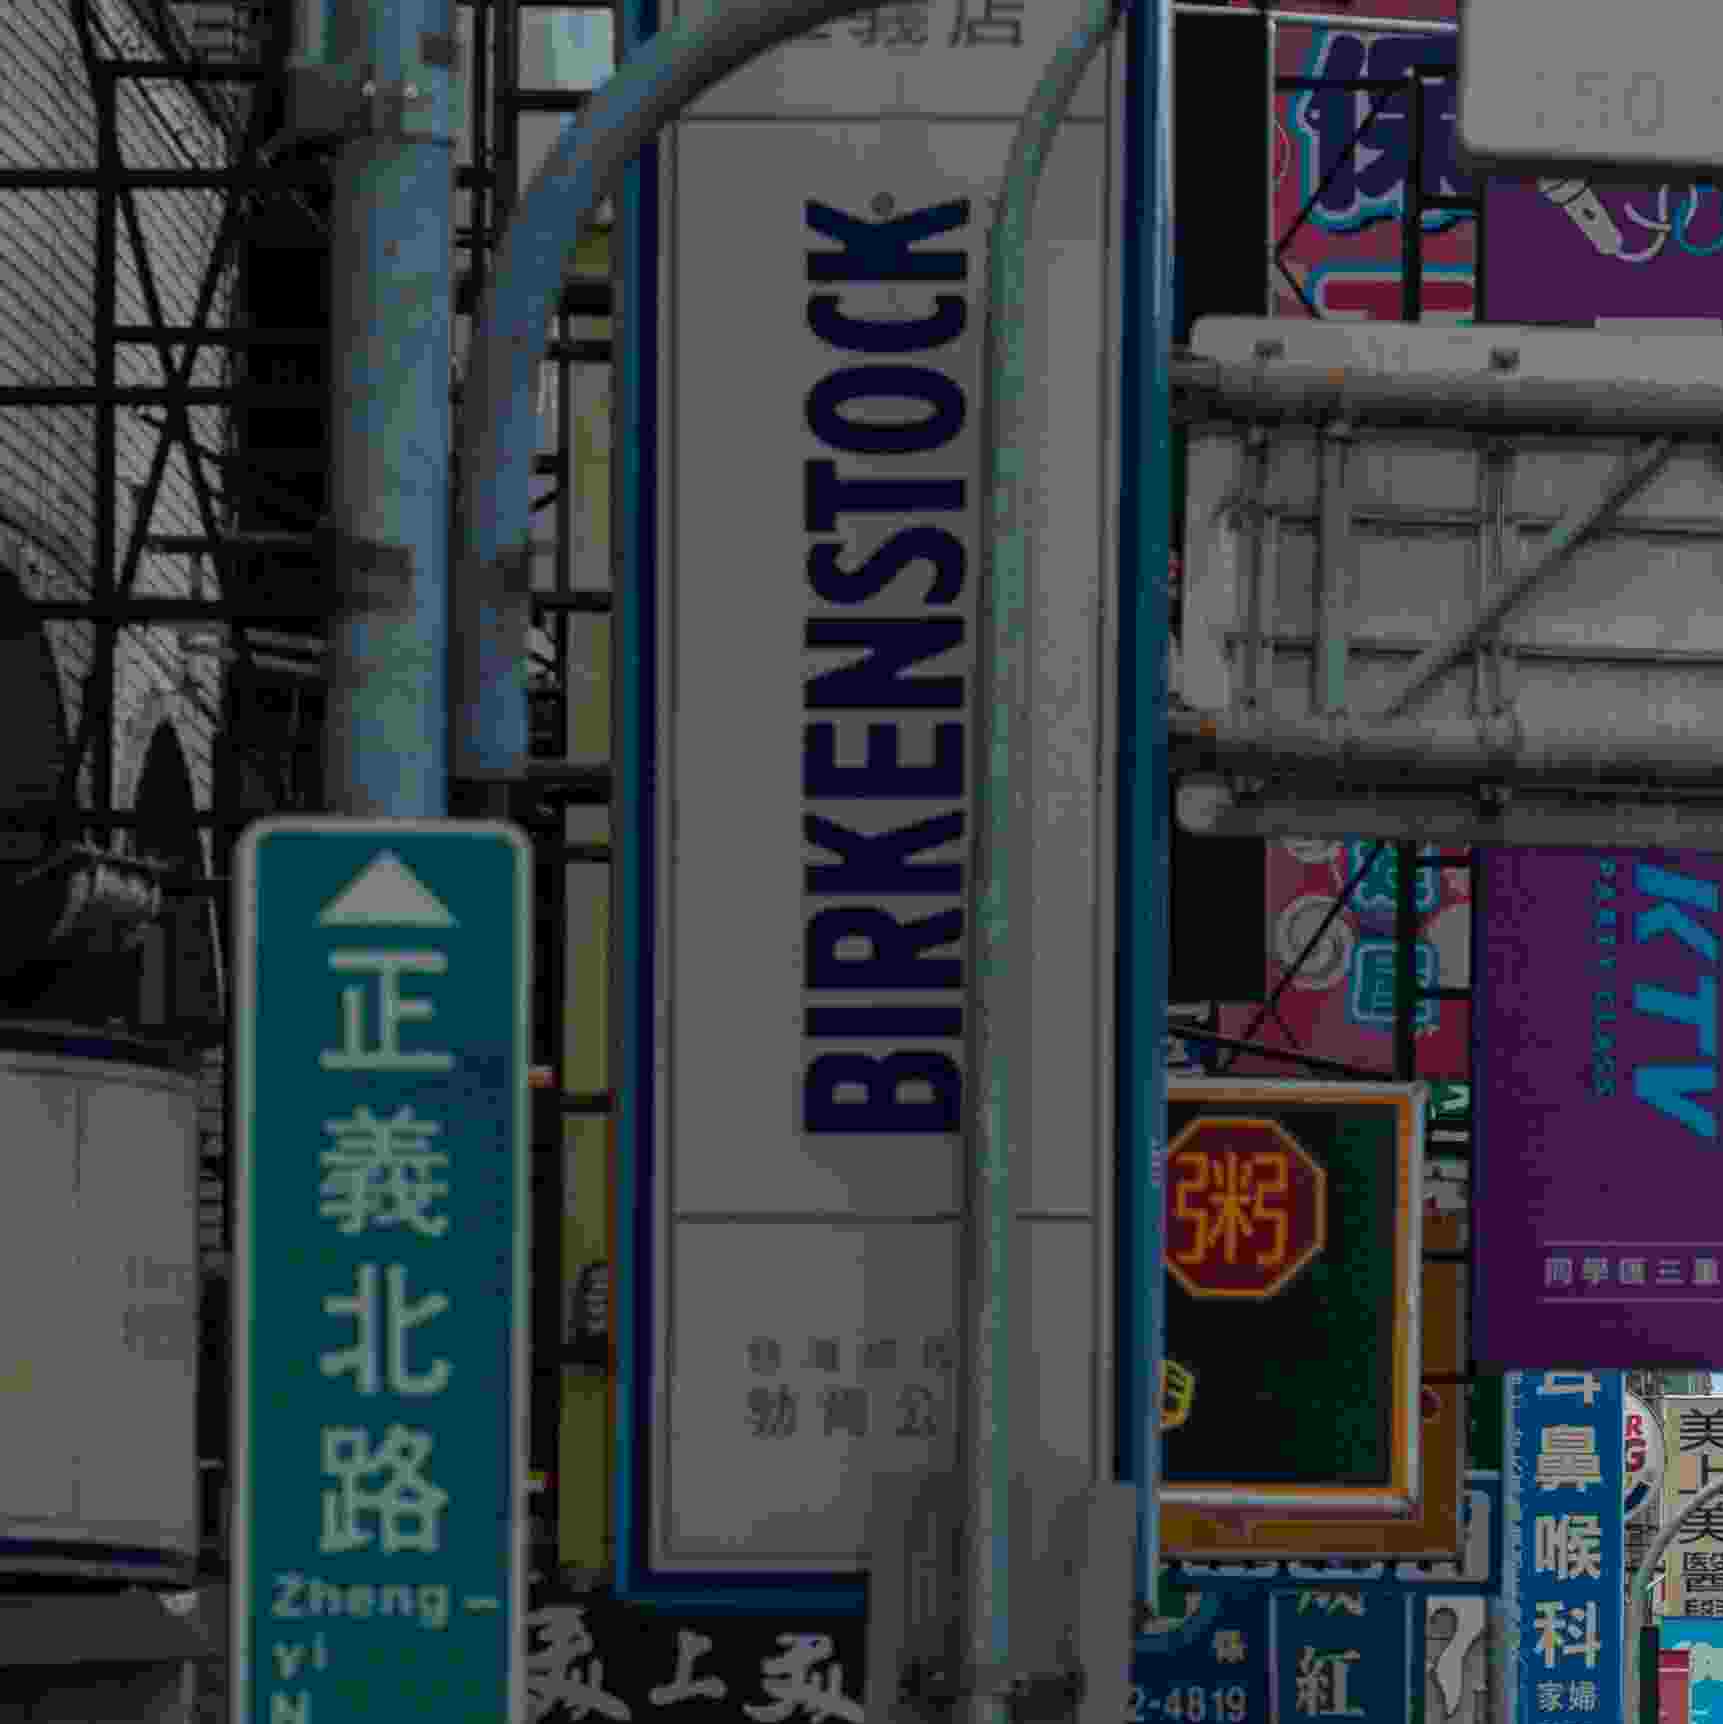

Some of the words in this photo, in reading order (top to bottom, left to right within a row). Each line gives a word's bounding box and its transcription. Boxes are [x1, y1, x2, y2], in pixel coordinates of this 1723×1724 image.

[804, 199, 969, 1135] BIRKENSTOCK
[1173, 1150, 1290, 1265] 粥
[1632, 862, 1722, 1140] KTV
[319, 948, 454, 1554] 正義北路
